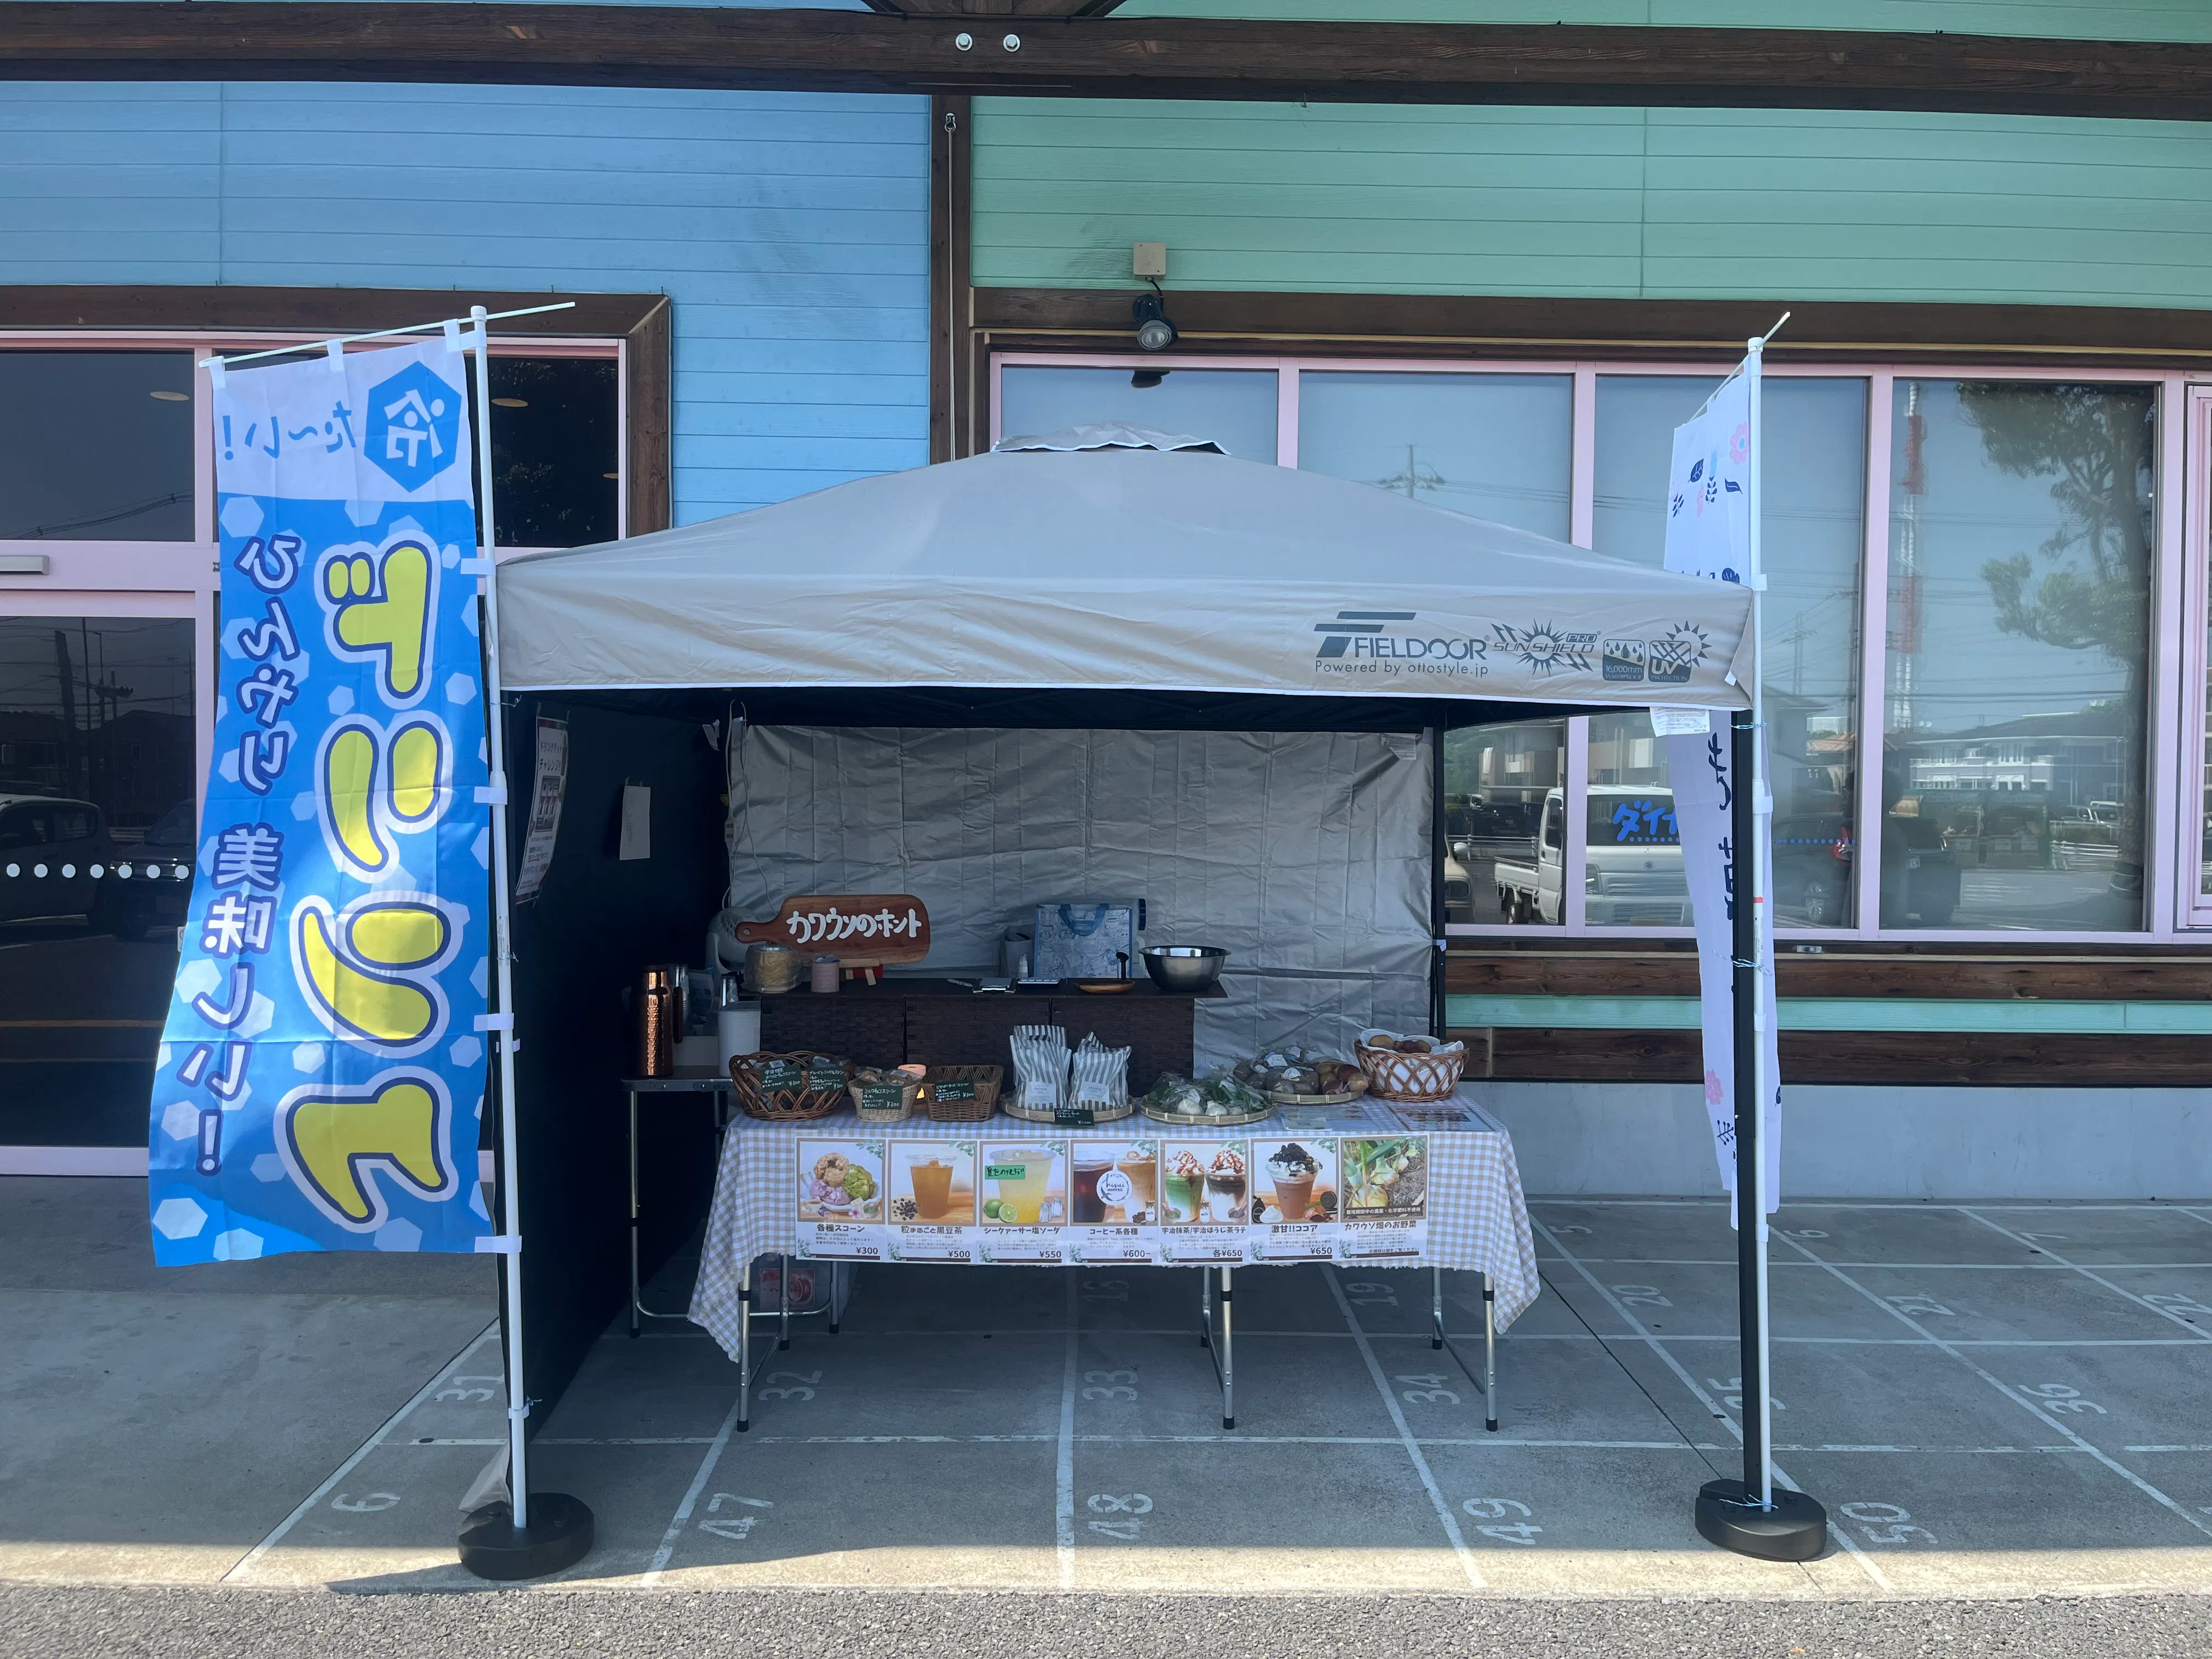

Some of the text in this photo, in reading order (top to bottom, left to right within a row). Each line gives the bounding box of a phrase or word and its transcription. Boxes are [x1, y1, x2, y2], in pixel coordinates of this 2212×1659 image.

[1315, 660, 1488, 678] Powered by ottostyle.jp
[1605, 665, 1643, 674] 16,000mm
[1651, 659, 1679, 674] UV
[817, 1223, 865, 1232] 各種スコーン
[901, 1226, 962, 1234] 粒まるごと黒豆茶
[1344, 1220, 1417, 1231] カワウソ畑のお野菜
[1610, 1284, 1675, 1307] 20
[758, 1370, 822, 1401] 32
[1082, 1370, 1139, 1401] 33
[1395, 1372, 1461, 1404] 34
[2017, 1383, 2108, 1415] 36
[697, 1492, 774, 1540] 47
[1087, 1493, 1153, 1540] 48
[1462, 1497, 1543, 1545] 49
[1839, 1501, 1939, 1545] 50
